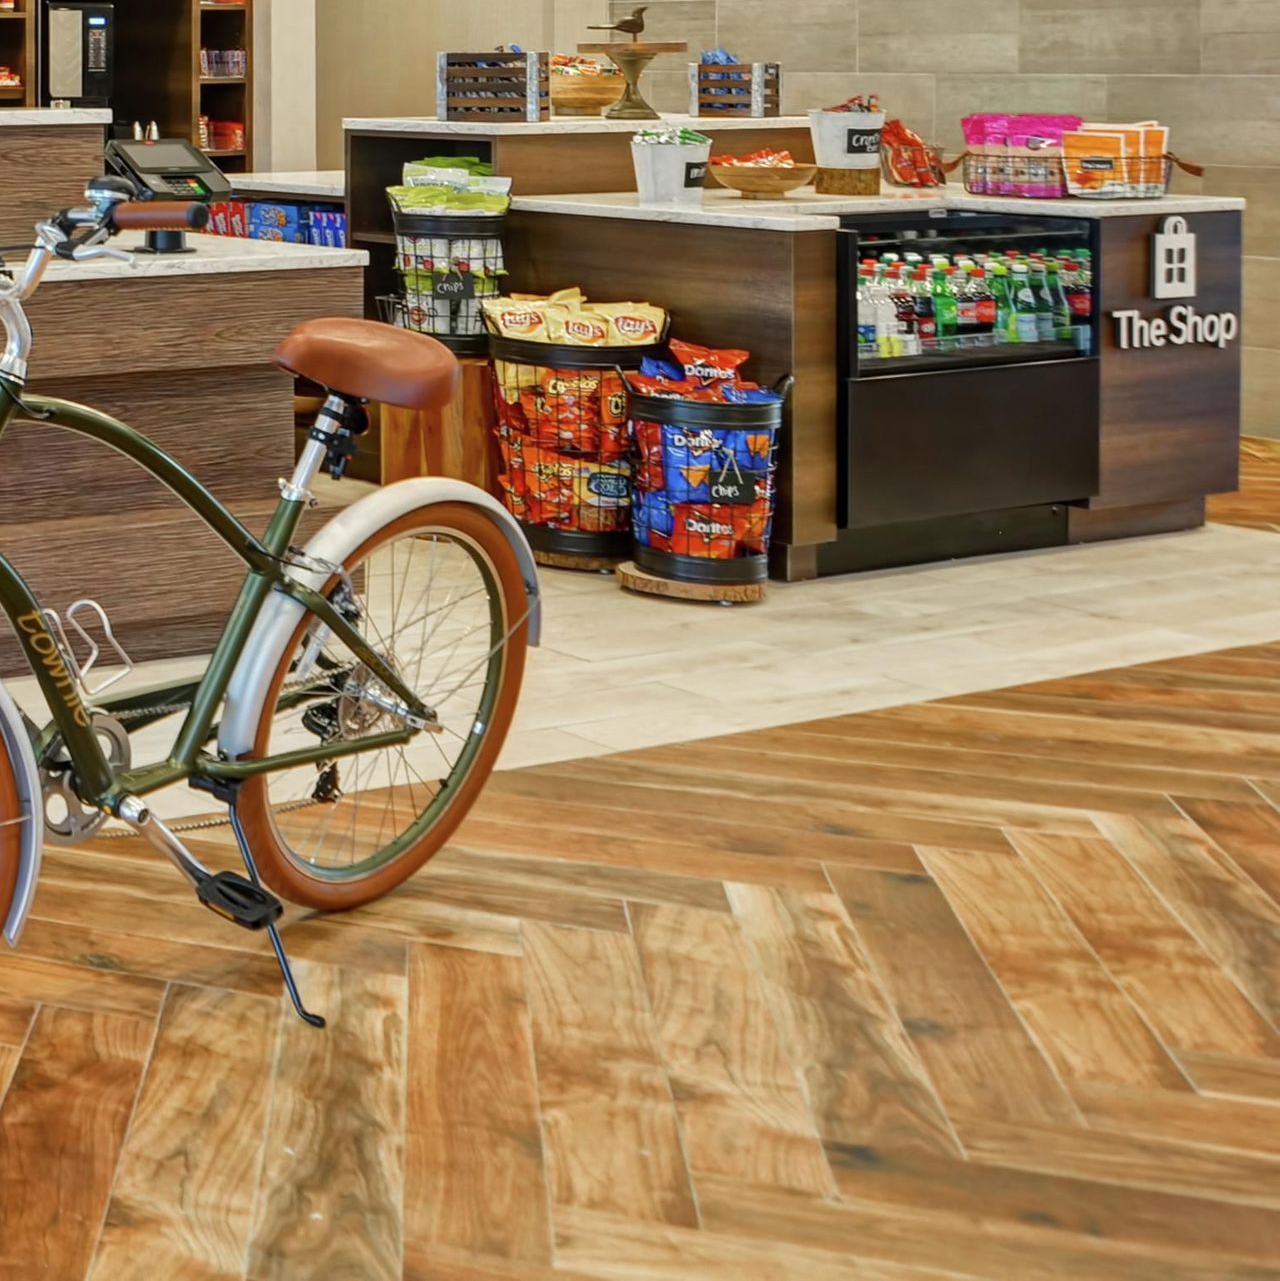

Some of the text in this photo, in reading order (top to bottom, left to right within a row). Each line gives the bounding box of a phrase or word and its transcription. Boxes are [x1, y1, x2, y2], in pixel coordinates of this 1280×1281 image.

[1112, 305, 1237, 349] The Shop
[684, 364, 735, 379] Doritos
[17, 610, 90, 727] townie
